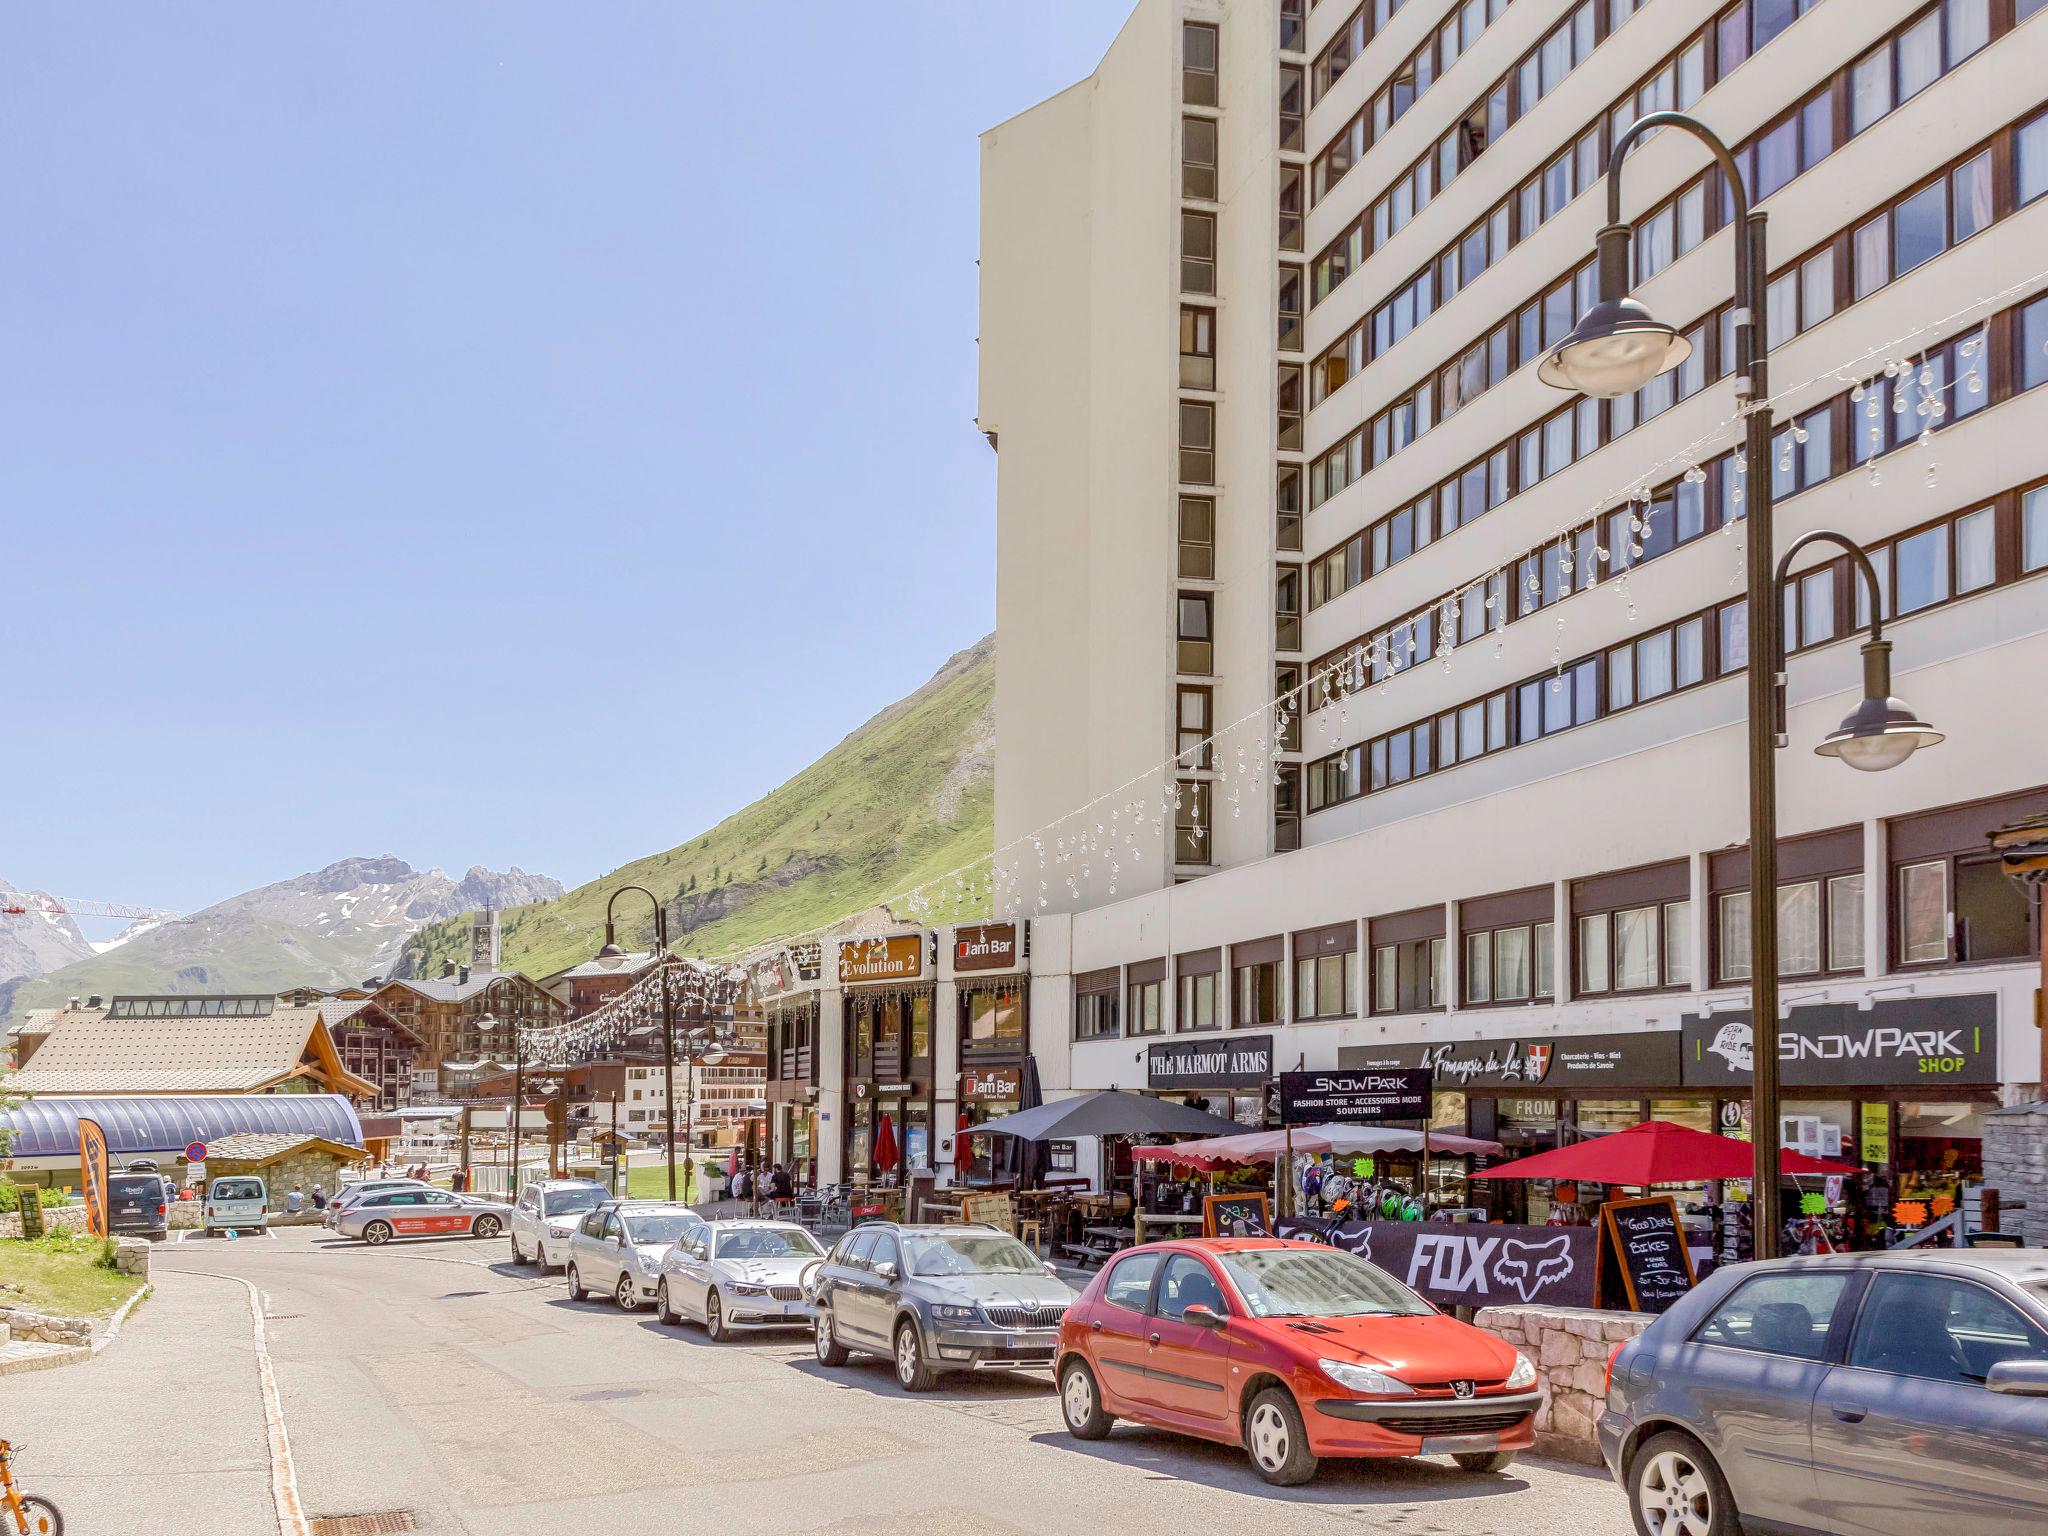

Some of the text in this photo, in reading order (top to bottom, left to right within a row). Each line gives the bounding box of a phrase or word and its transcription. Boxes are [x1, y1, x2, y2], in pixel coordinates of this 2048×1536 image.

[991, 940, 1011, 953] Bar
[844, 955, 915, 976] Evolution 2
[1151, 1051, 1267, 1075] THE MARMOT ARMS
[1434, 1044, 1483, 1084] Fromagerie
[1485, 1051, 1499, 1072] du
[1501, 1042, 1520, 1079] Lac
[1918, 1057, 1966, 1073] SHOP
[996, 1079, 1016, 1093] Bar
[1293, 1099, 1323, 1108] FASHION
[1326, 1098, 1348, 1106] STORE
[1355, 1096, 1400, 1105] ACCESSOIRES
[1401, 1095, 1421, 1103] MODE
[1336, 1106, 1381, 1115] SOUVENIRS
[1629, 1240, 1670, 1254] BIKES
[1407, 1233, 1500, 1294] FOX
